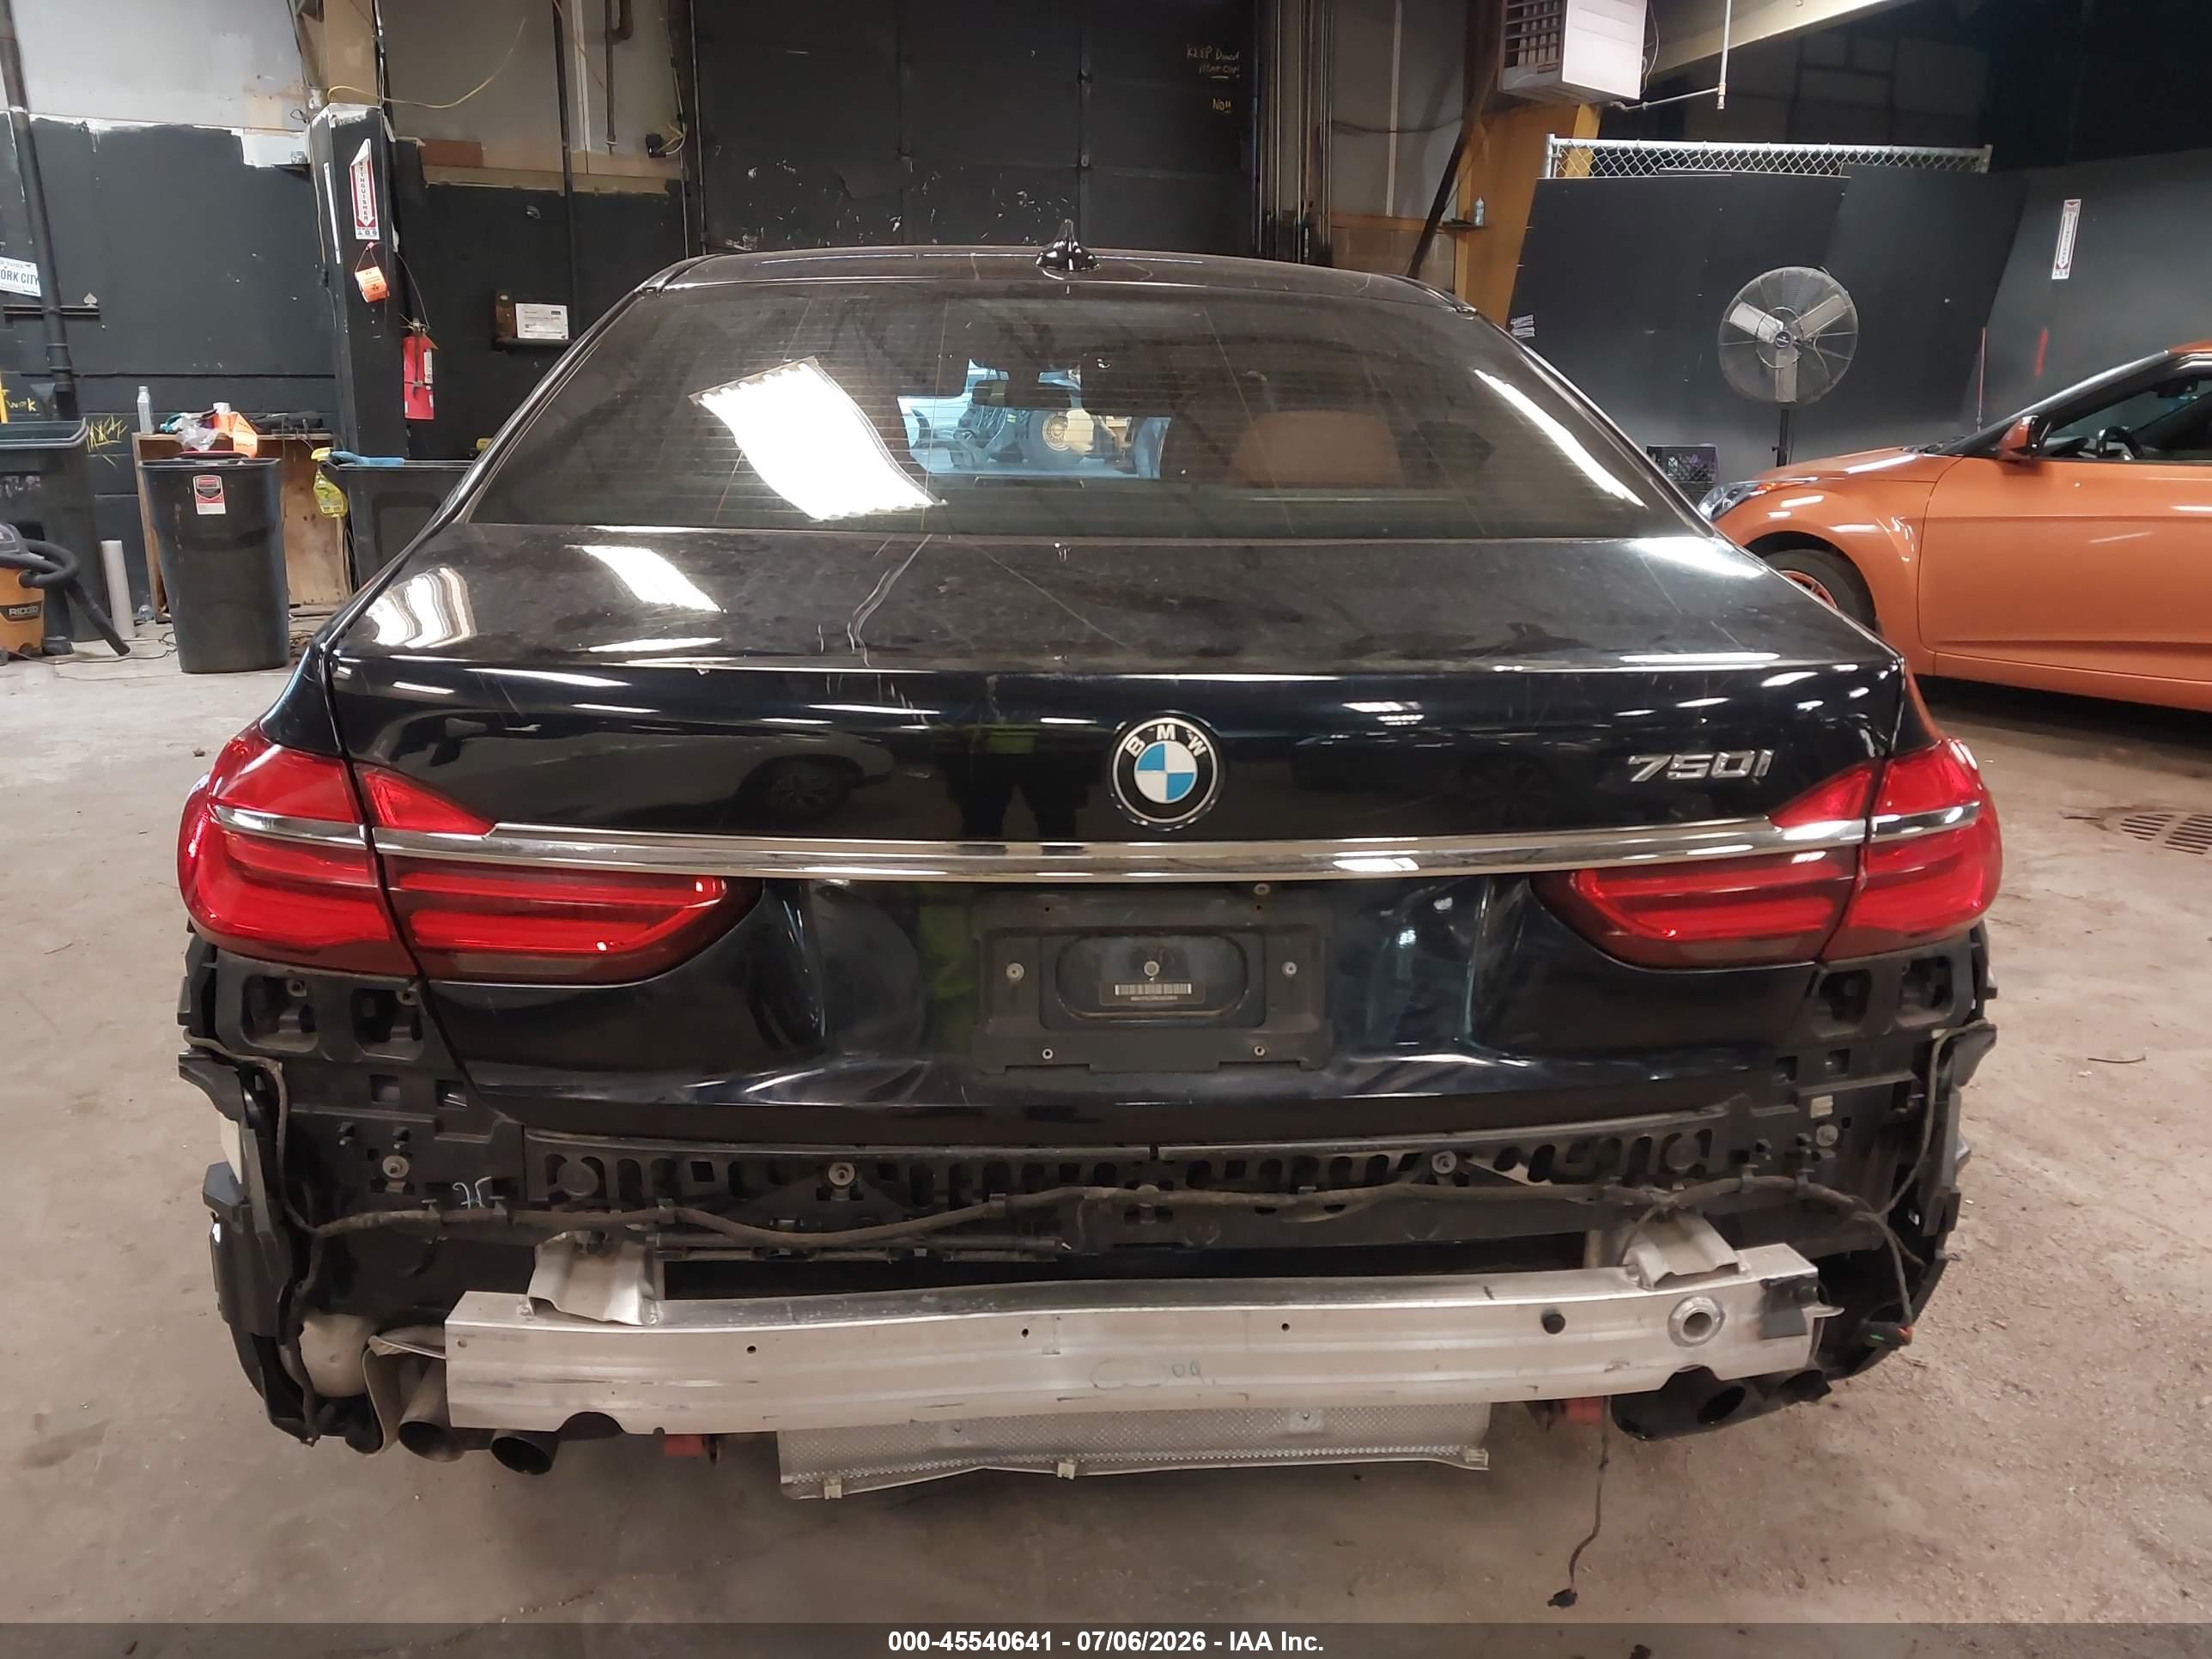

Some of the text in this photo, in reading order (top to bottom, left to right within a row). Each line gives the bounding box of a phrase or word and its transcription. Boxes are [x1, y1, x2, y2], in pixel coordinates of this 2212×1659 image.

[358, 159, 368, 221] XTINGUISHER
[0, 269, 38, 286] ORK CITY
[1125, 724, 1207, 757] BMW
